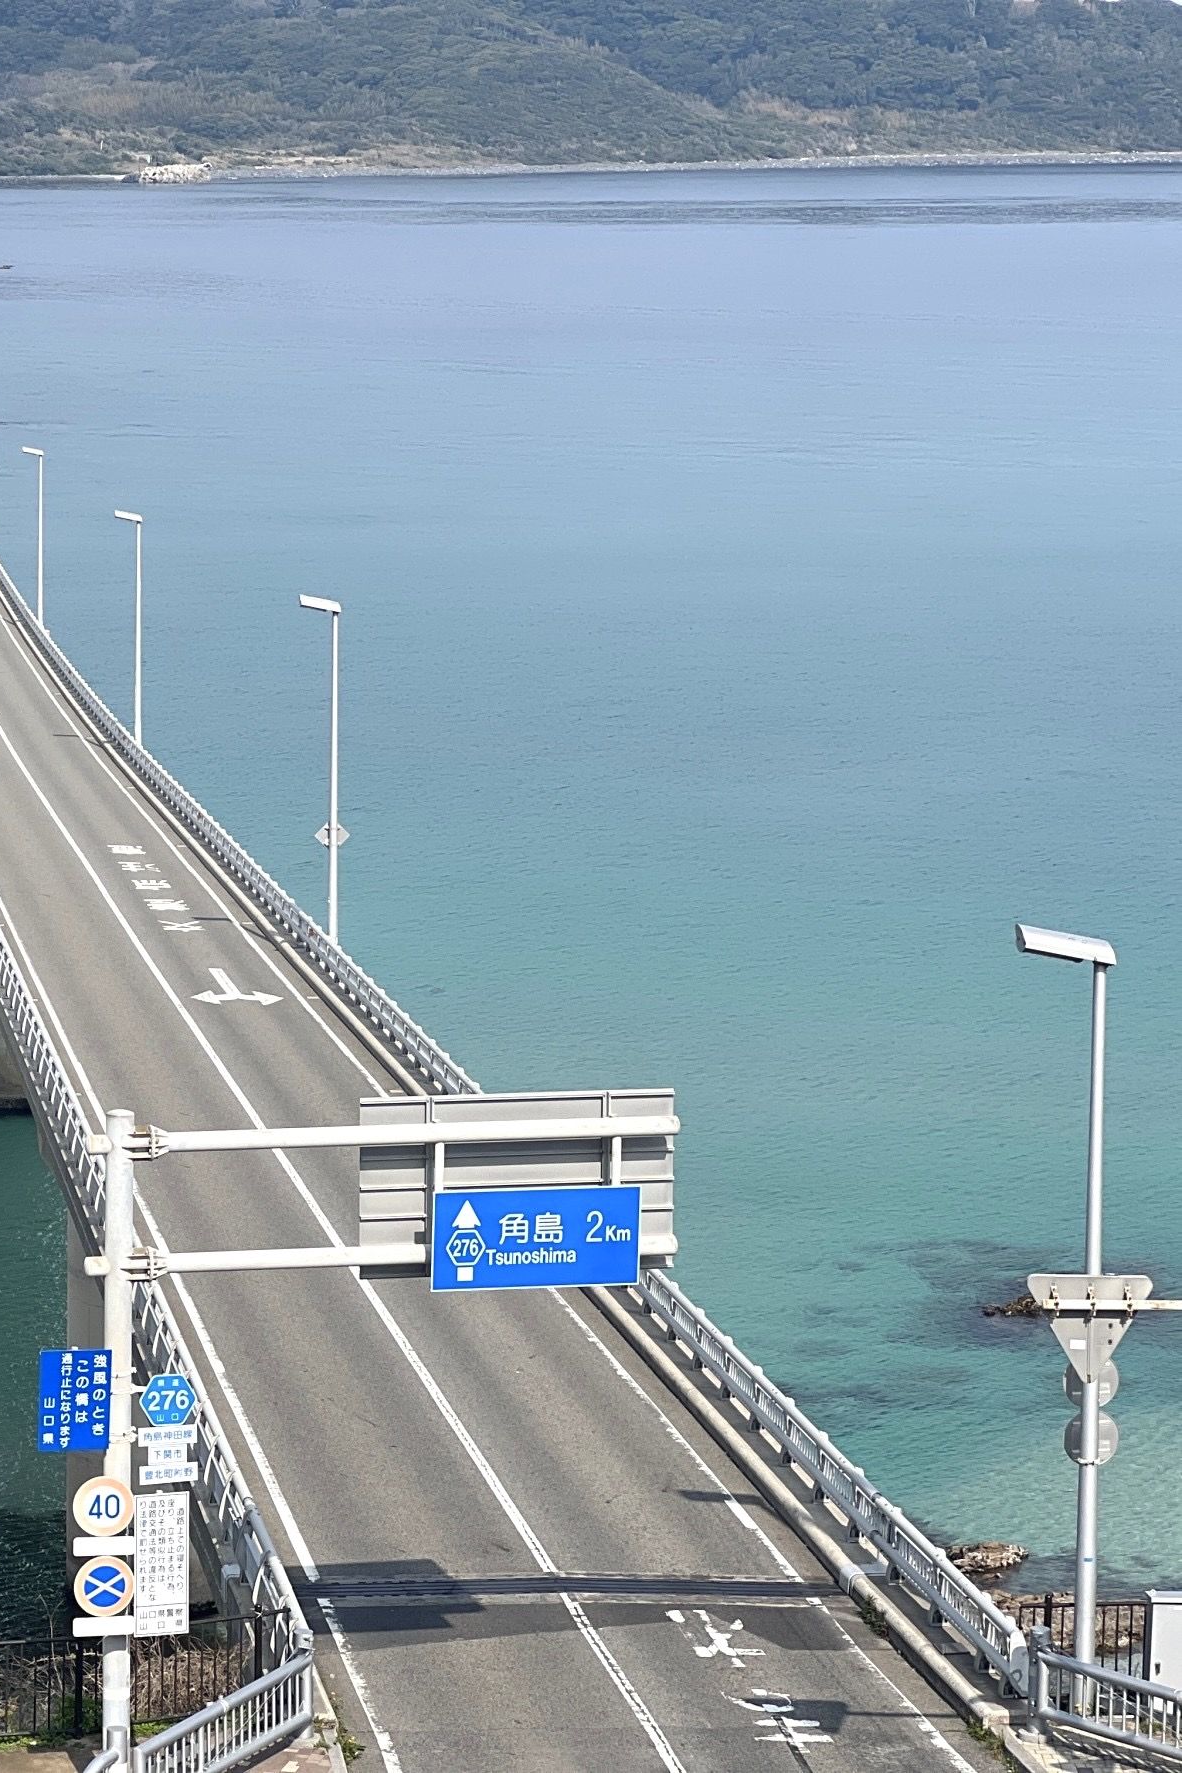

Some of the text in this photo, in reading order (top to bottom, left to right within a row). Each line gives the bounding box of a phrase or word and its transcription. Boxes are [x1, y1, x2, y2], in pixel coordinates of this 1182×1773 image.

[499, 1211, 564, 1245] 角島
[452, 1238, 479, 1258] 276
[486, 1248, 577, 1266] Tsunoshima
[59, 1353, 73, 1448] 通行止になります
[74, 1359, 90, 1424] この橋は
[92, 1354, 108, 1436] 強風のとき
[147, 1389, 190, 1411] 276
[42, 1397, 56, 1445] 山口県
[156, 1412, 179, 1422] 山口
[153, 1449, 182, 1460] 下関市
[88, 1494, 121, 1520] 40
